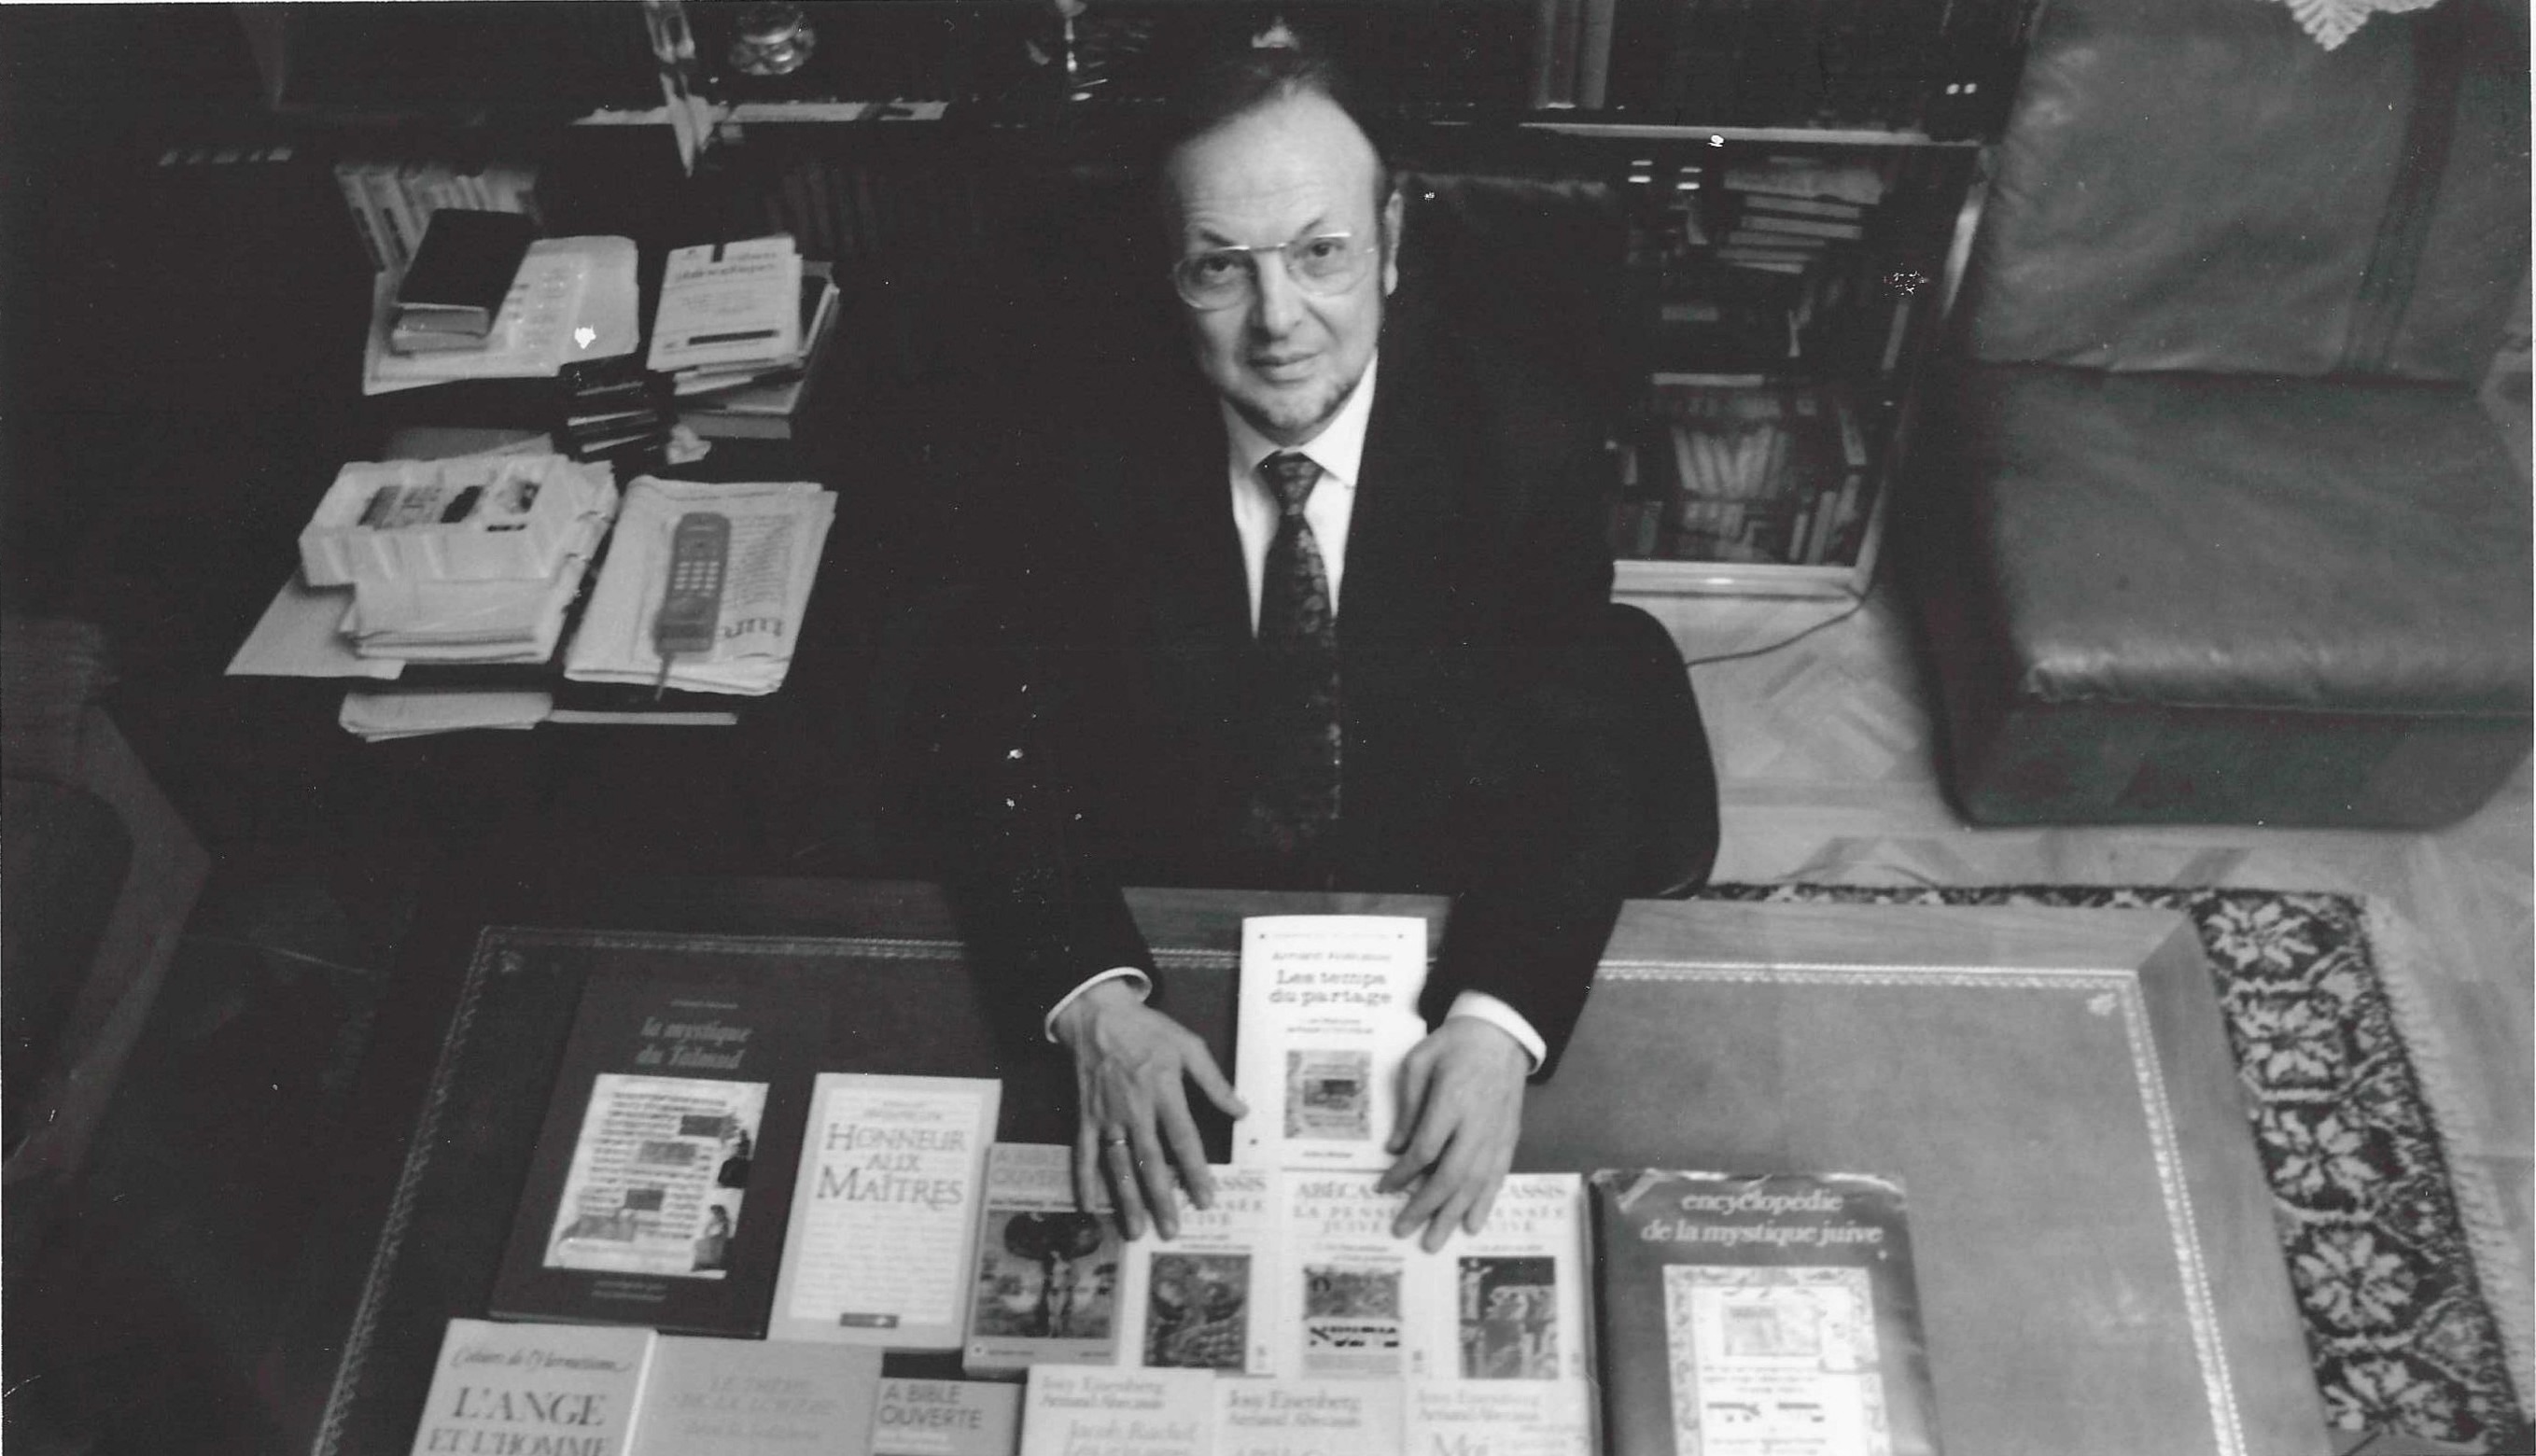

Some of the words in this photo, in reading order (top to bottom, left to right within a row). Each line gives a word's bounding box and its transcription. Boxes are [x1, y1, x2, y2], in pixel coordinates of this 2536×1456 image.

[1276, 969, 1315, 985] Les
[1320, 972, 1387, 988] temps
[1268, 988, 1297, 1004] du
[1300, 990, 1393, 1007] partage
[824, 1122, 965, 1153] HONNEUR
[865, 1154, 920, 1172] AUX
[1681, 1188, 1844, 1216] encyclopédie
[1640, 1219, 1673, 1243] de
[1675, 1218, 1699, 1242] la
[1702, 1219, 1817, 1248] mystique
[1815, 1219, 1885, 1248] juive
[882, 1382, 900, 1401] A
[906, 1382, 961, 1405] BIBLE
[453, 1387, 607, 1427] L'ANGE
[879, 1405, 983, 1429] OUVERTE
[427, 1428, 469, 1452] ET
